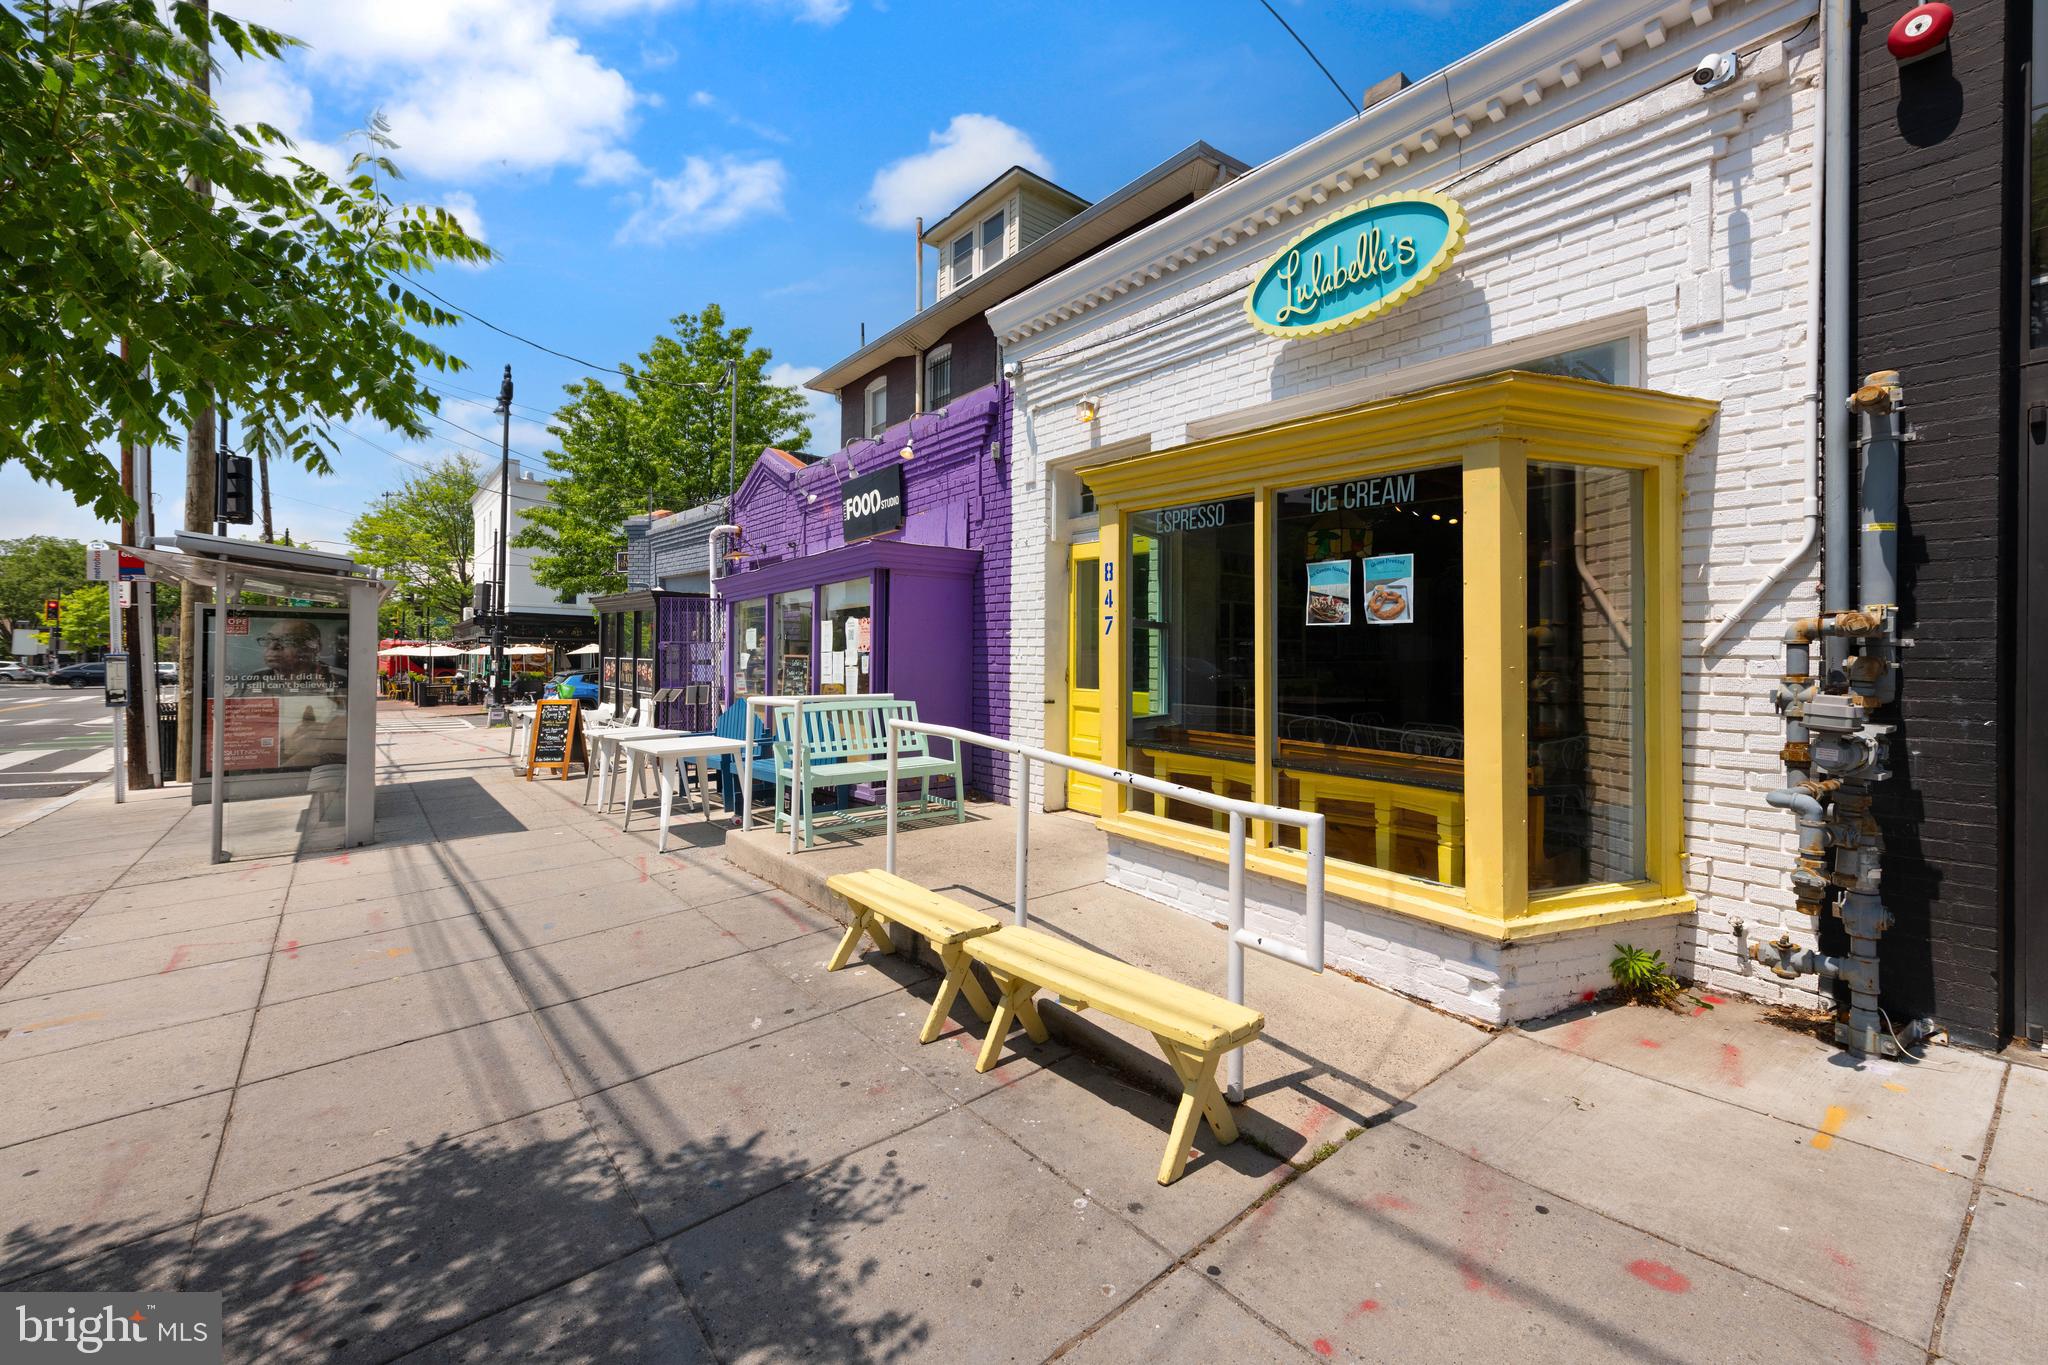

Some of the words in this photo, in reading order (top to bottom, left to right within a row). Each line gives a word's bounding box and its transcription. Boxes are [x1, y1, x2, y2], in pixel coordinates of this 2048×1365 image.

[1277, 227, 1415, 323] Lulabelle's
[846, 489, 881, 520] FOOD
[880, 495, 900, 510] STUDIO
[1311, 485, 1338, 513] ICE
[1344, 474, 1415, 509] CREAM
[1156, 503, 1225, 535] ESPRESSO
[241, 673, 260, 682] can
[262, 672, 287, 684] quit.
[296, 672, 313, 681] did
[315, 672, 326, 681] it.
[247, 680, 265, 690] still
[267, 680, 292, 690] can't
[293, 680, 327, 689] believe
